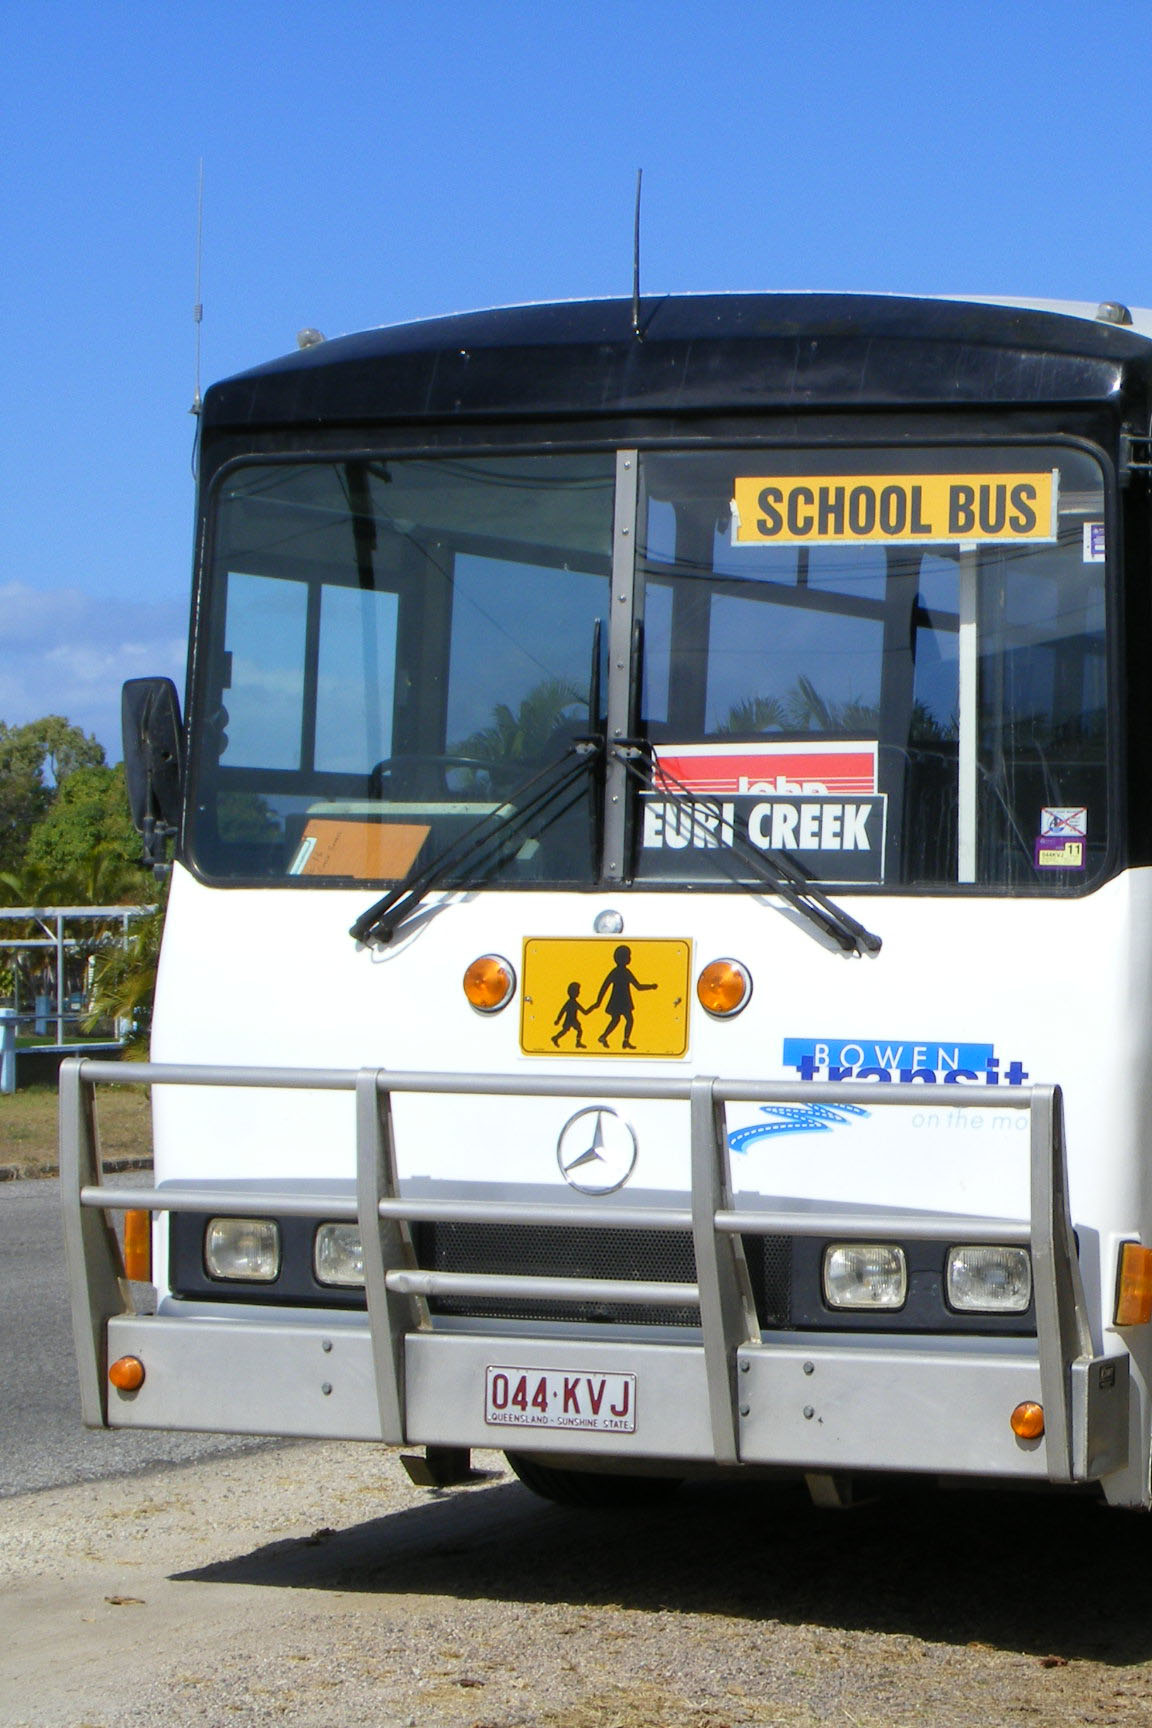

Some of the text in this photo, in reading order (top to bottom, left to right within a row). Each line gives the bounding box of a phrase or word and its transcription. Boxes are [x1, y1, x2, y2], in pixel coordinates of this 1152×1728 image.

[756, 483, 1038, 537] SCHOOL BUS
[643, 802, 873, 850] EURI CREEK
[814, 1043, 959, 1070] BOWEN
[911, 1107, 1029, 1130] on the mo
[491, 1412, 549, 1425] QUEENSLAND
[557, 1416, 598, 1428] SUNSHINE
[603, 1419, 629, 1430] STATE
